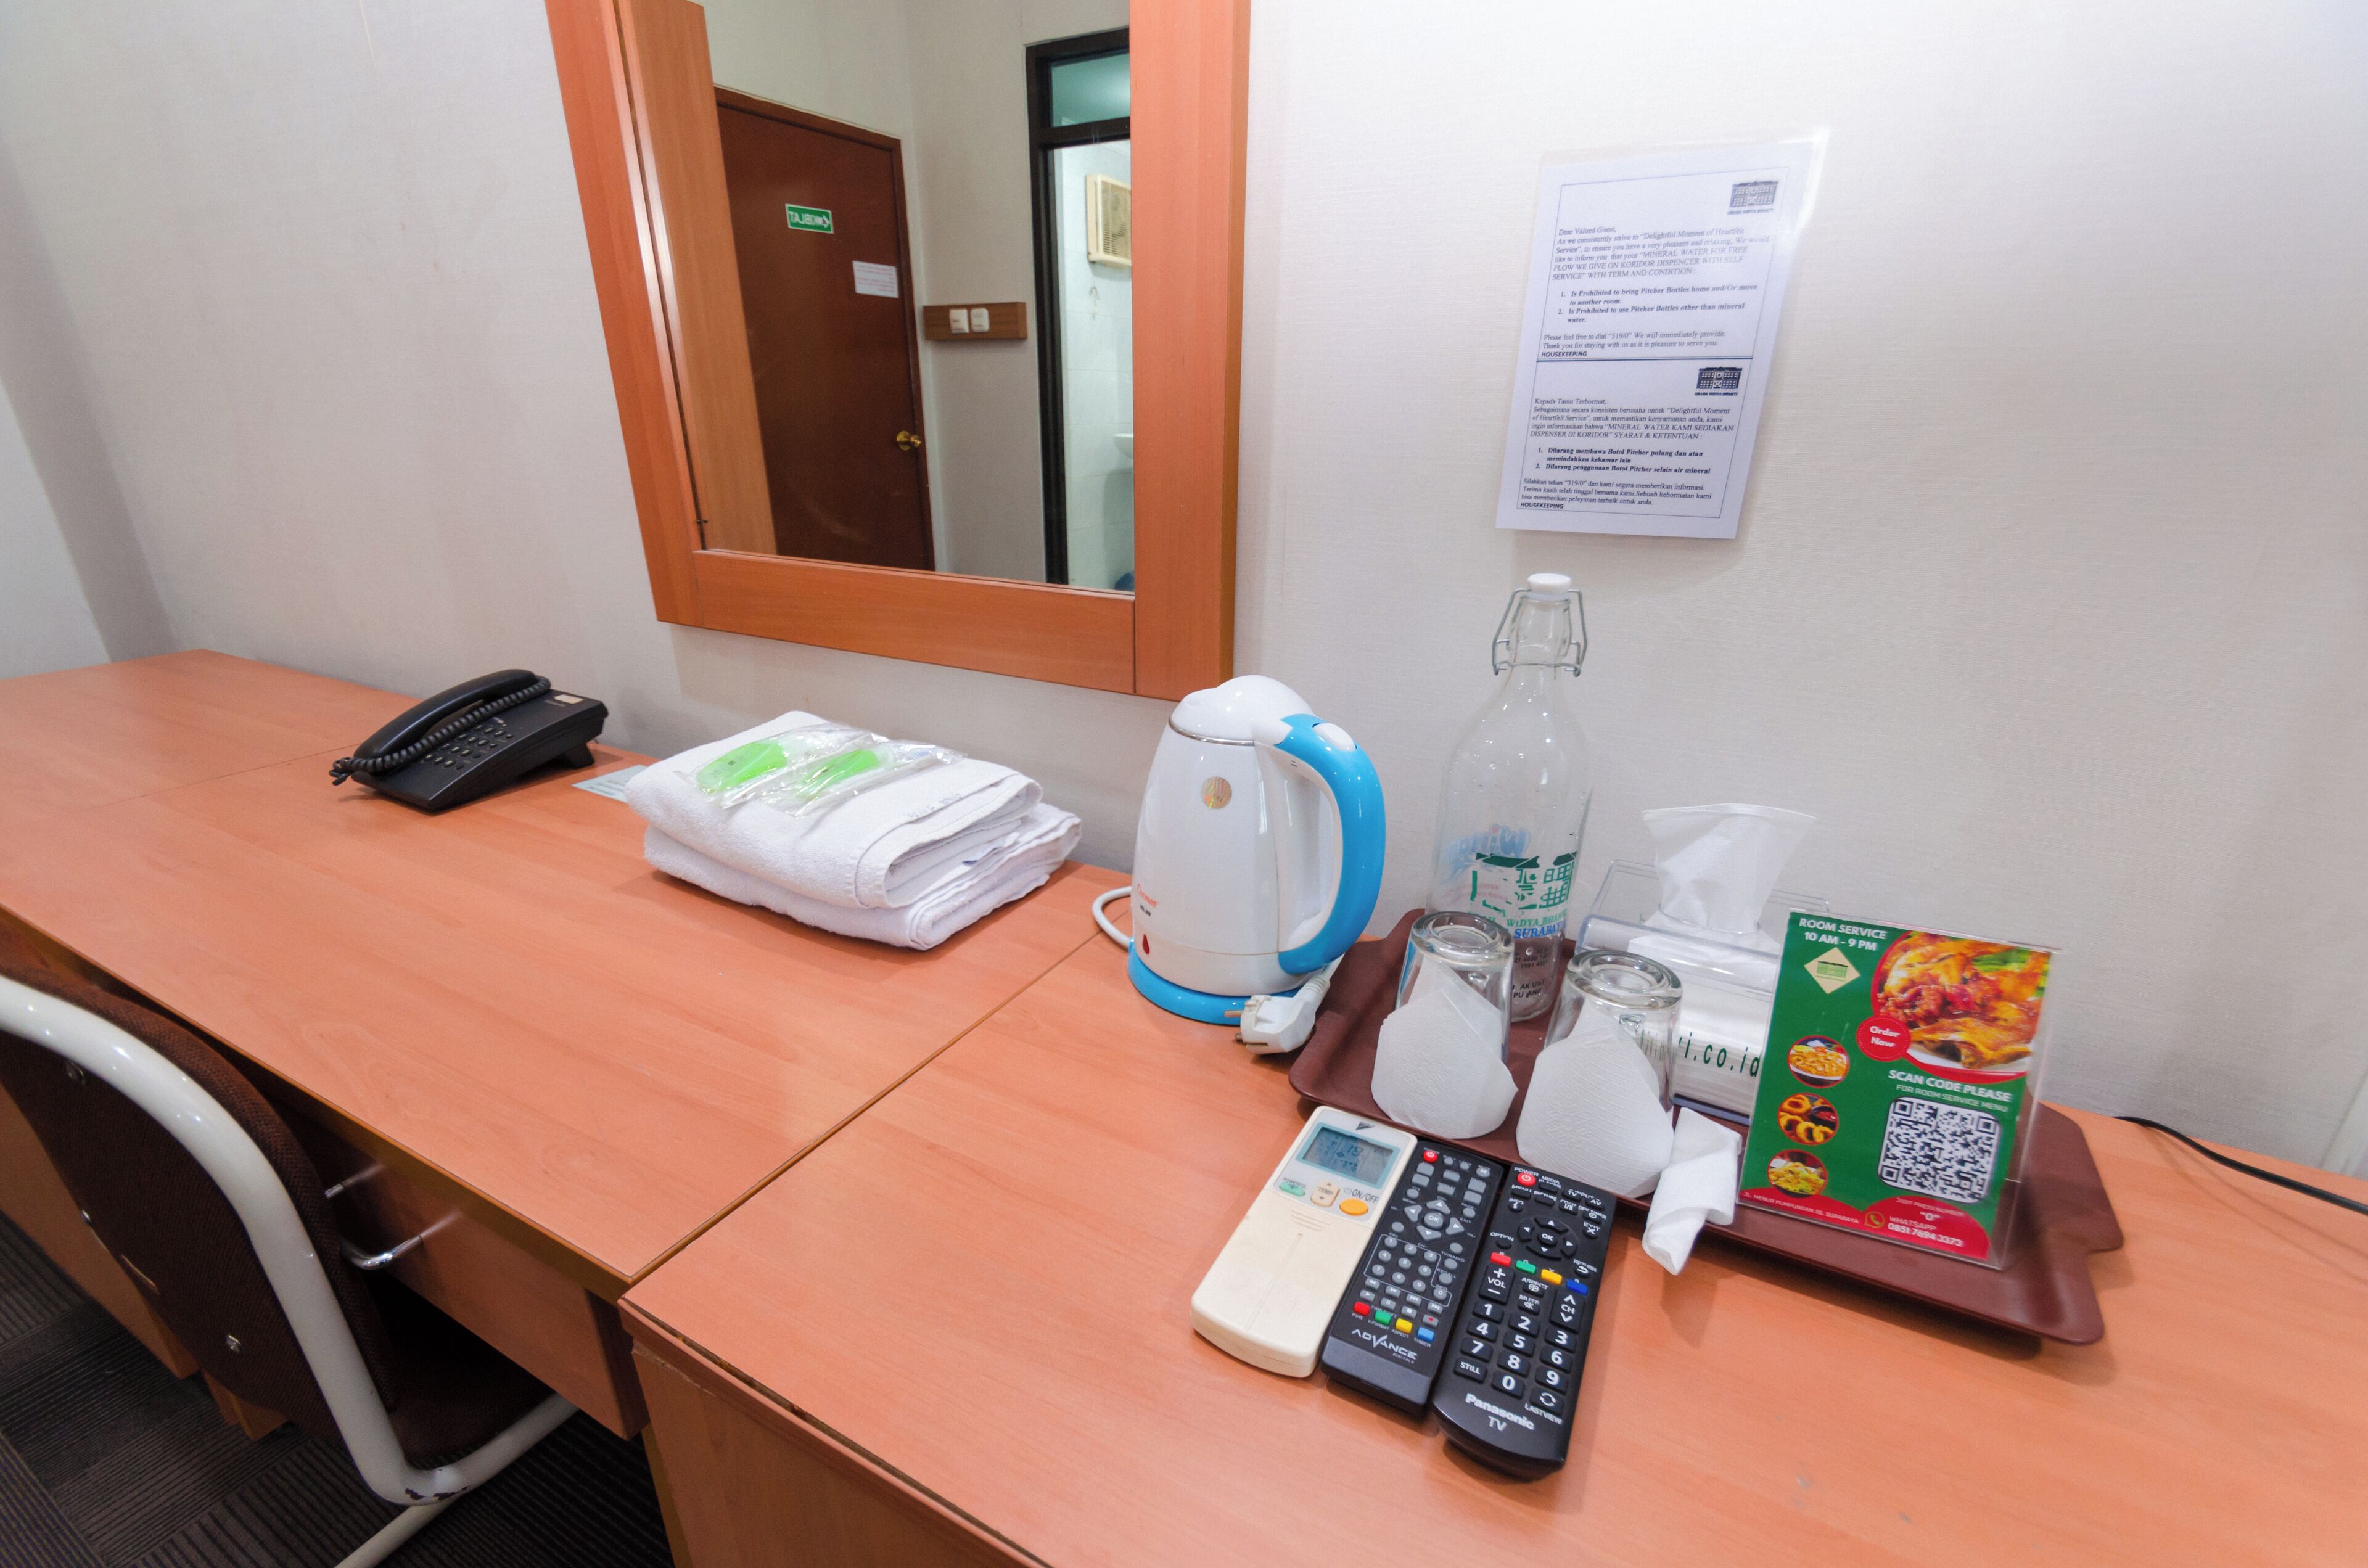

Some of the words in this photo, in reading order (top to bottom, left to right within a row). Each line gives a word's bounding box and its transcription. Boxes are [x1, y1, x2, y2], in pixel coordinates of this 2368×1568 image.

[1700, 330, 1726, 339] provide.
[1799, 918, 1836, 932] ROOM
[1838, 924, 1887, 940] SERVICE
[1804, 932, 1817, 941] 10
[1819, 935, 1839, 945] AM
[1848, 938, 1856, 947] 9
[1858, 940, 1877, 951] PM
[1869, 1025, 1900, 1038] Order
[1871, 1036, 1895, 1048] Now
[1888, 1069, 1924, 1085] SCAN
[1925, 1077, 1962, 1093] CODE
[1963, 1084, 2012, 1102] PLEASE
[1896, 1084, 1914, 1093] FOR
[1915, 1088, 1941, 1098] ROOM
[1941, 1093, 1980, 1106] SERVICE
[1981, 1101, 2008, 1112] MENU
[1514, 1167, 1539, 1177] POWER
[1542, 1176, 1560, 1184] MEDIA
[1318, 1186, 1333, 1196] TEMP
[1352, 1189, 1379, 1204] ON/OFF
[1753, 1194, 1775, 1204] MENUR
[1775, 1199, 1814, 1213] PUMPUNGAN
[1825, 1212, 1860, 1224] SURABAYA
[1914, 1202, 1935, 1211] PRESS
[1936, 1207, 1965, 1217] NUMBER
[1428, 1215, 1440, 1223] OK
[1889, 1215, 1936, 1231] WHATSAPP
[1583, 1221, 1600, 1231] EXIT
[1490, 1231, 1515, 1242] OPTION
[1542, 1233, 1554, 1241] OK
[1888, 1223, 1910, 1234] 0851
[1911, 1228, 1936, 1240] 7694
[1938, 1233, 1964, 1247] 3373
[1441, 1251, 1465, 1263] TV/RADIO
[1487, 1276, 1506, 1289] VOL
[1522, 1277, 1548, 1290] ASPECT
[1519, 1294, 1540, 1305] MUTE
[1484, 1303, 1492, 1316] 1
[1561, 1304, 1575, 1315] CH
[1368, 1319, 1390, 1331] V-FORMAT
[1476, 1323, 1488, 1336] 4
[1518, 1316, 1531, 1331] 2
[1392, 1329, 1409, 1339] ASPECT
[1555, 1330, 1568, 1345] 3
[1351, 1329, 1417, 1360] ADVANCE
[1413, 1337, 1431, 1348] TIMER
[1471, 1340, 1484, 1354] 7
[1513, 1334, 1526, 1348] 5
[1507, 1354, 1521, 1369] 8
[1550, 1350, 1563, 1365] 6
[1460, 1361, 1480, 1374] STILL
[1502, 1375, 1515, 1390] 0
[1546, 1370, 1560, 1385] 9
[1465, 1392, 1535, 1430] Panasonic
[1488, 1416, 1507, 1432] TV
